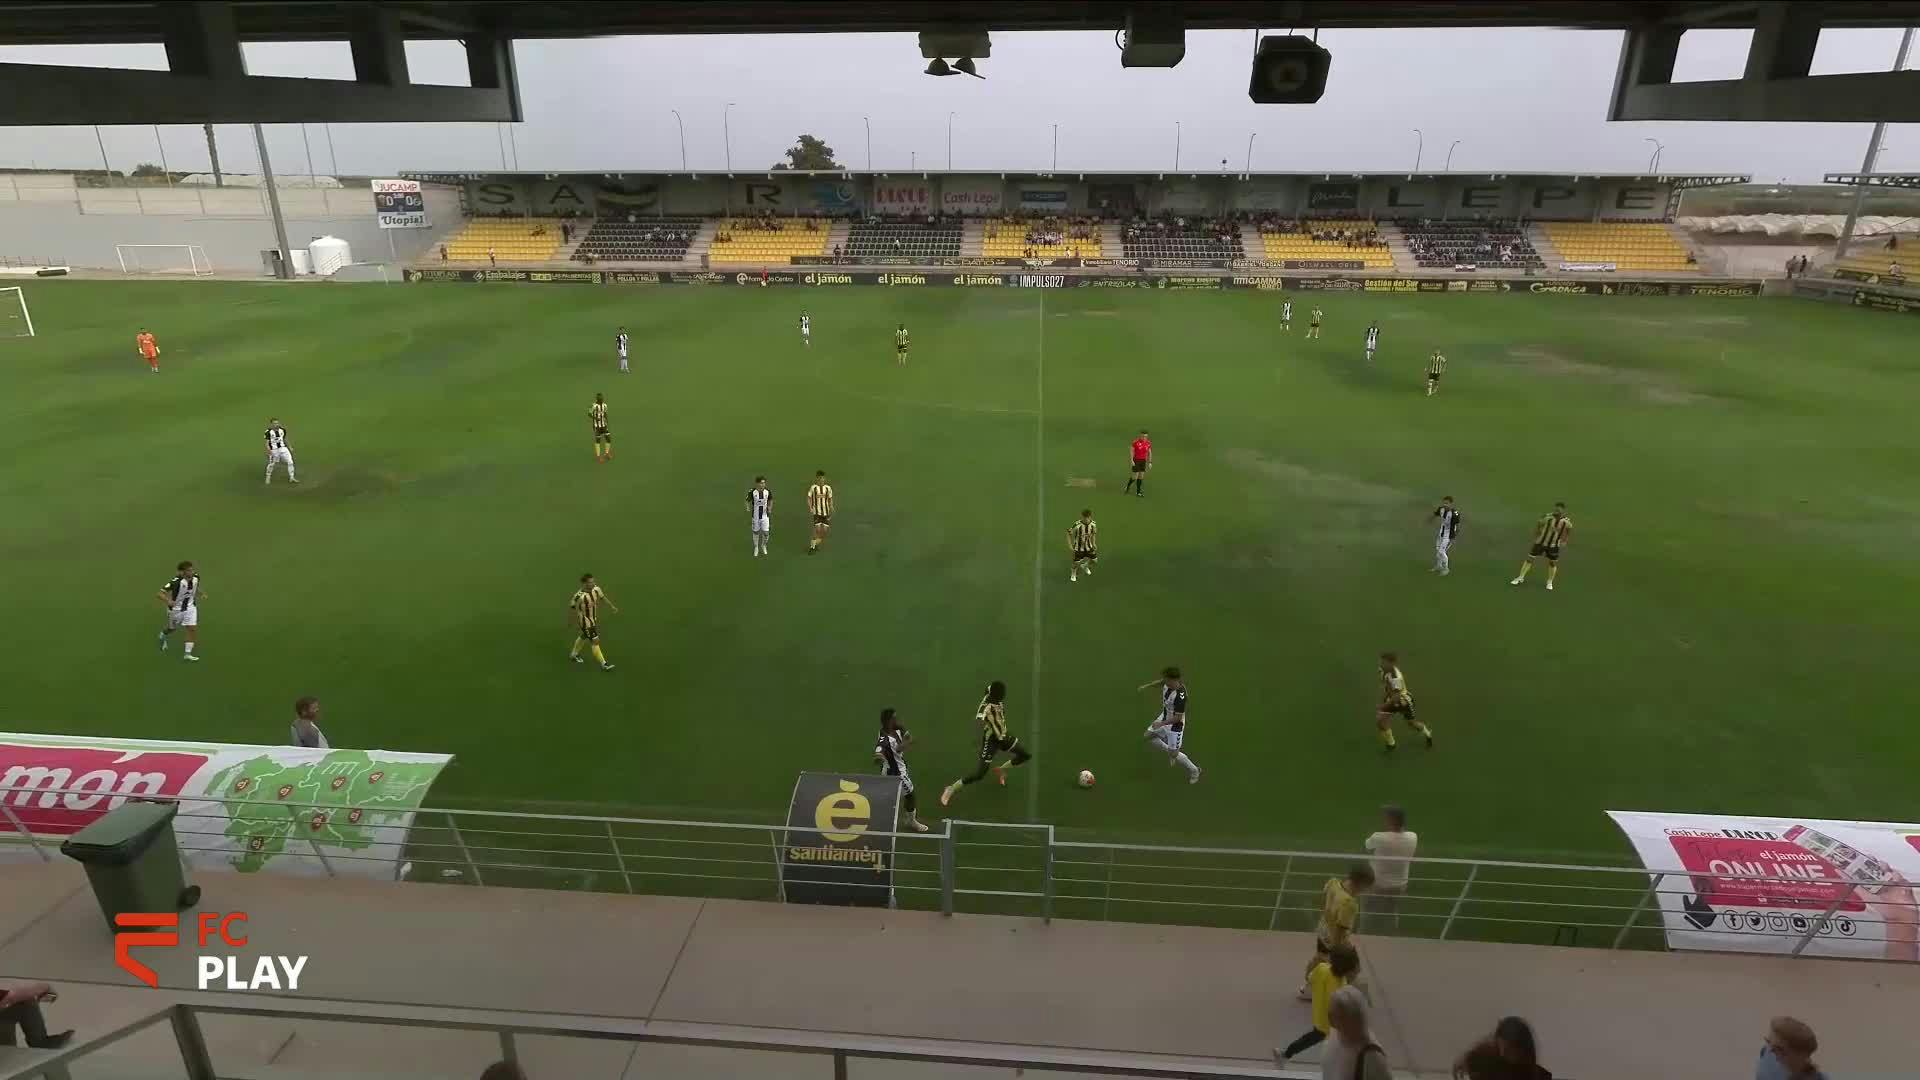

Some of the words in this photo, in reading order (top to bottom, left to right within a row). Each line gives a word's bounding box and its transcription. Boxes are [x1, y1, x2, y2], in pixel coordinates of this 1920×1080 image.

[944, 192, 970, 203] Cash
[805, 275, 815, 284] el
[816, 274, 852, 285] jamón
[878, 275, 888, 284] el
[889, 274, 926, 285] jamón
[953, 275, 964, 285] el
[965, 275, 1002, 286] jamón
[1020, 275, 1065, 288] IMPULSO27
[1249, 277, 1283, 285] GAMMA
[1365, 279, 1392, 287] Gestión
[1690, 288, 1753, 296] TENORIO
[1664, 829, 1692, 837] Cash
[1760, 850, 1771, 860] el
[1773, 851, 1819, 862] jamón
[1709, 859, 1833, 886] ONLINE
